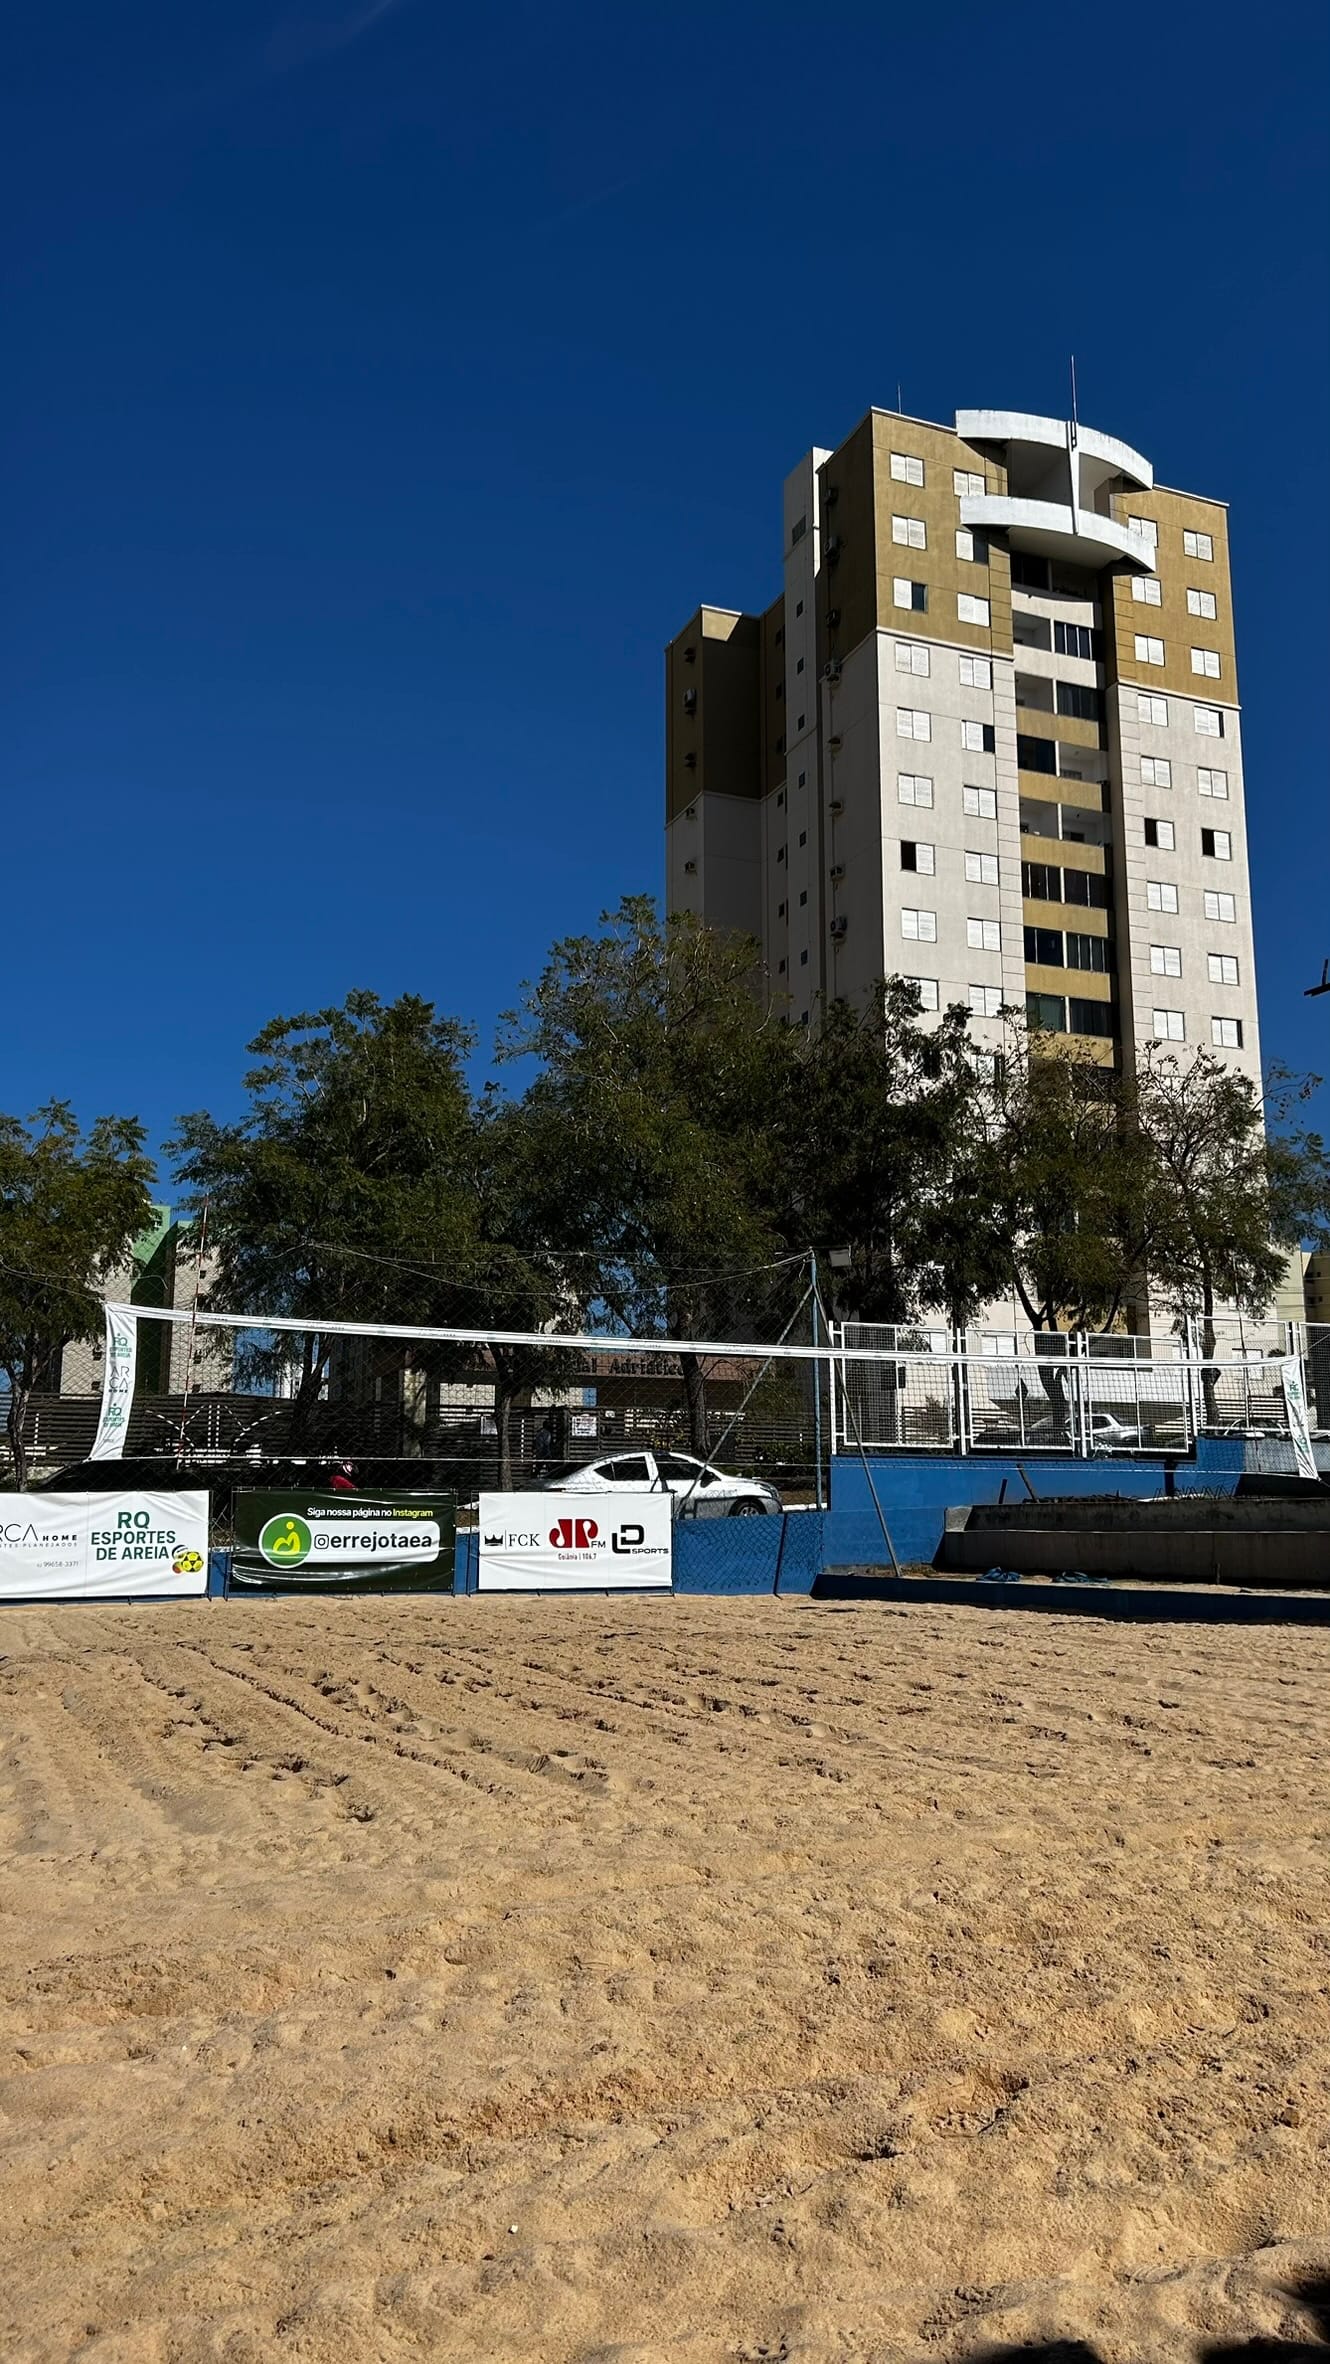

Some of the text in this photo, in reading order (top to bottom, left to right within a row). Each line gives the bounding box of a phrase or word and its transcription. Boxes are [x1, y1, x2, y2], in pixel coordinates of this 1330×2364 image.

[117, 1511, 150, 1529] RQ
[307, 1507, 326, 1518] Siga
[326, 1509, 351, 1517] nossa
[352, 1508, 380, 1518] página
[393, 1508, 433, 1518] Instagram
[0, 1523, 38, 1542] CA
[91, 1530, 176, 1545] ESPORTES
[508, 1533, 541, 1547] FCK
[549, 1519, 606, 1548] JP FM
[330, 1531, 432, 1552] errejotaea
[96, 1546, 169, 1560] DE AREIA
